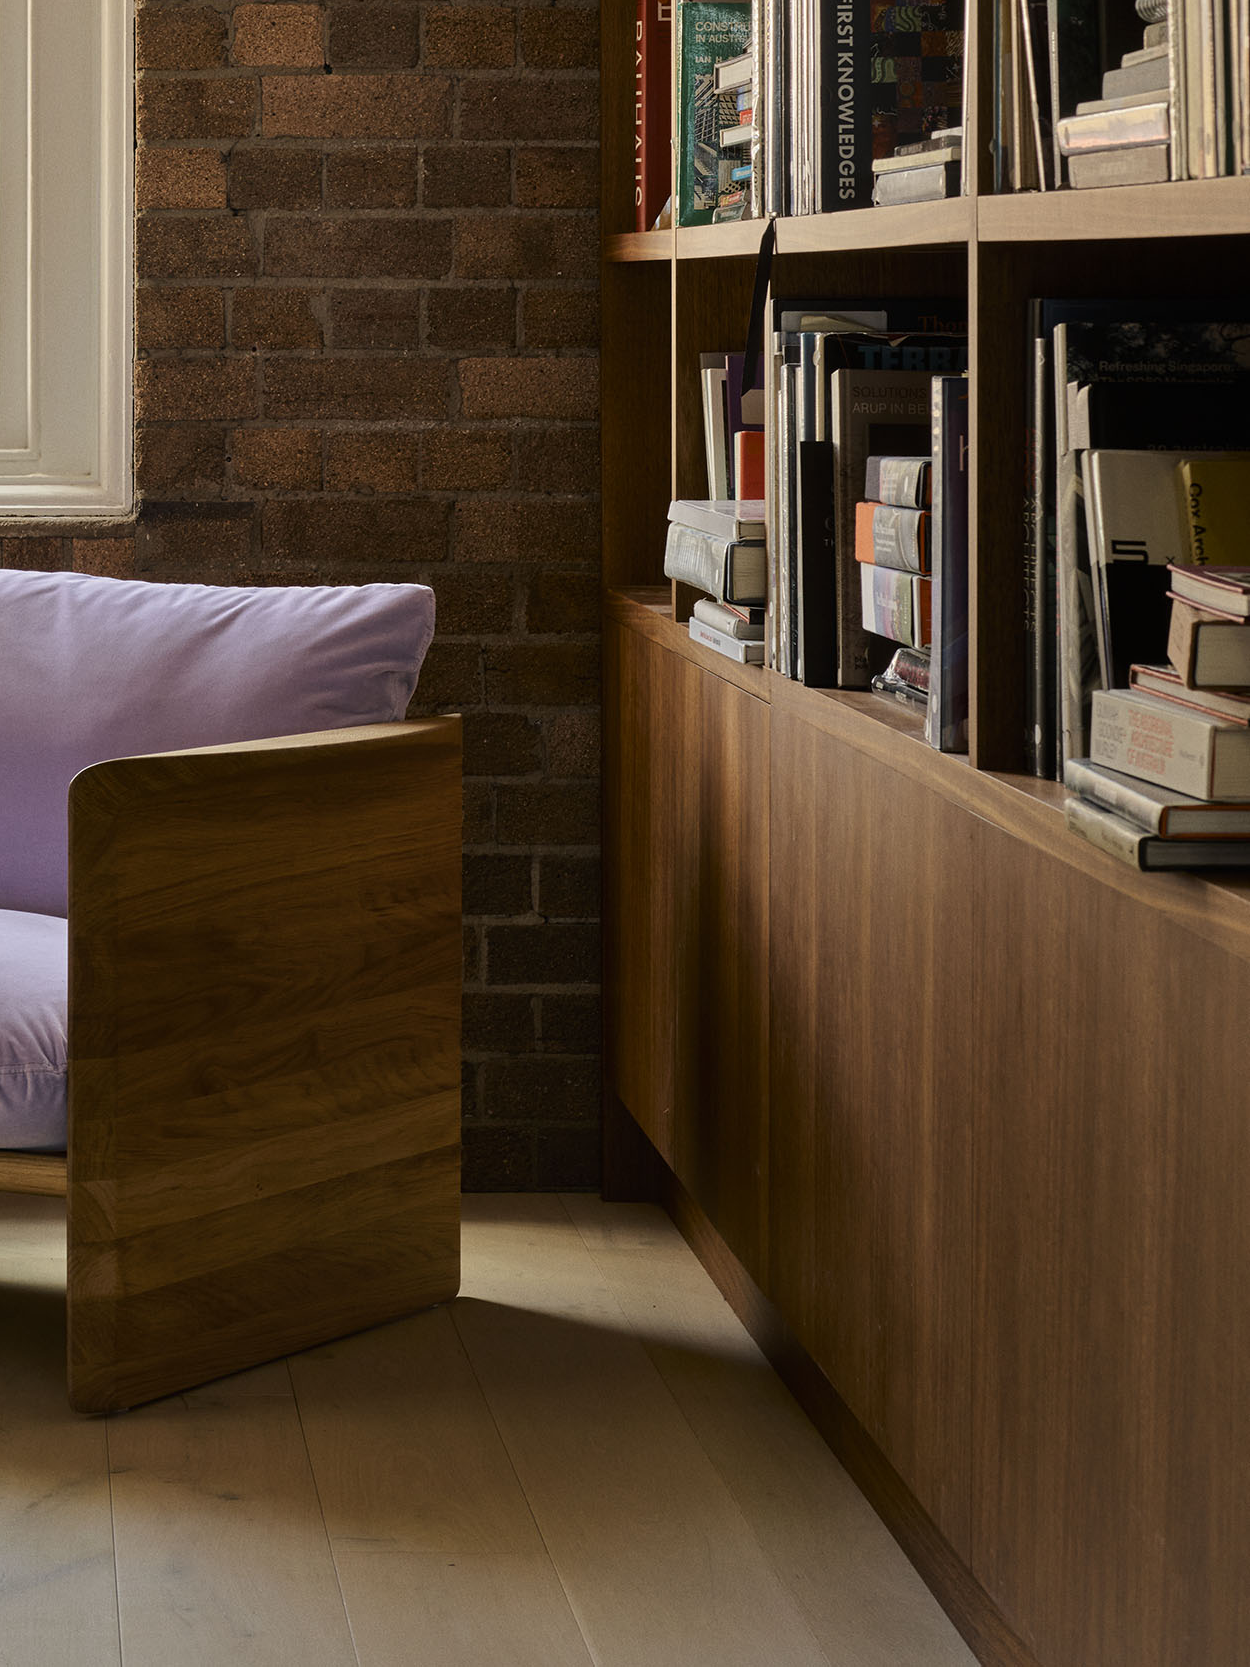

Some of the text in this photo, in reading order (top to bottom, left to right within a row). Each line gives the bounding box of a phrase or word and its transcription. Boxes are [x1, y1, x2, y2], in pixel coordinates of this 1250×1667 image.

[695, 34, 706, 43] IN
[695, 55, 712, 64] IAN
[836, 52, 857, 201] KNOWLEDGES
[1099, 359, 1166, 375] Refreshing
[852, 385, 927, 399] SOLUTIONS
[852, 402, 887, 414] ARUP
[890, 403, 904, 415] IN
[1190, 482, 1203, 519] Cox
